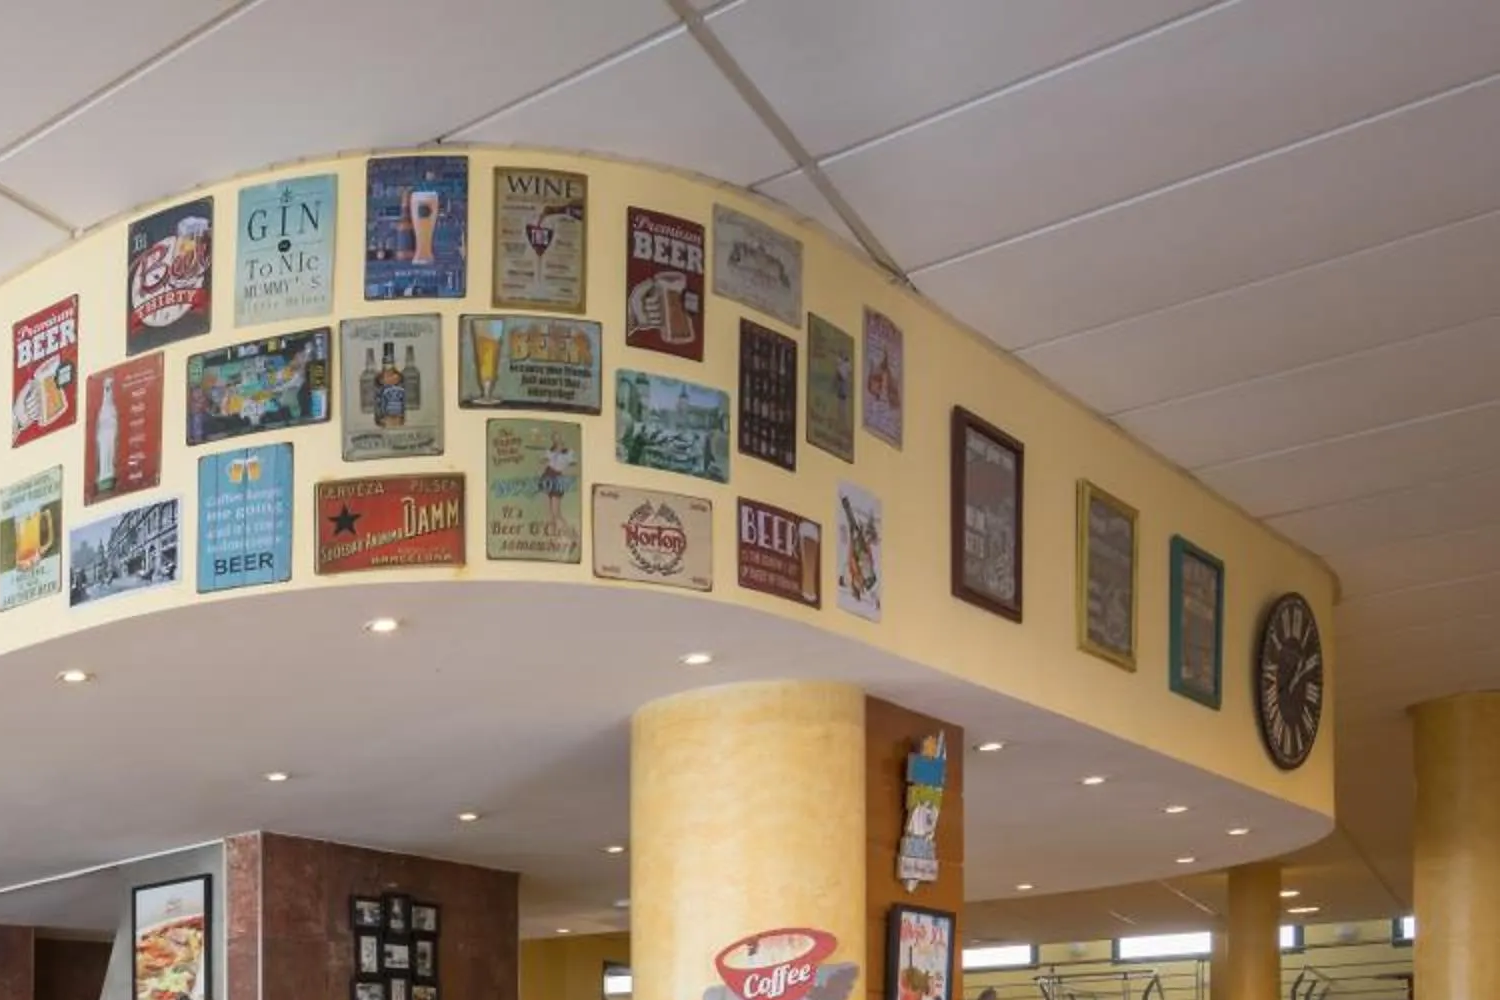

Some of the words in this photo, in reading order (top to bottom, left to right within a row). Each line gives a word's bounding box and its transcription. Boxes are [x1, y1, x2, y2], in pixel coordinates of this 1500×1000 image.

[507, 175, 580, 198] WINE
[248, 200, 322, 242] GIN
[633, 214, 701, 245] Premium
[633, 231, 703, 274] BEER
[137, 290, 197, 319] THIRTY
[17, 319, 75, 369] BEER
[319, 481, 385, 500] CERVEZA
[402, 496, 459, 537] DAMM
[740, 505, 799, 558] BEER
[621, 522, 687, 555] Norton
[214, 551, 274, 576] BEER
[744, 963, 811, 999] Coffee
